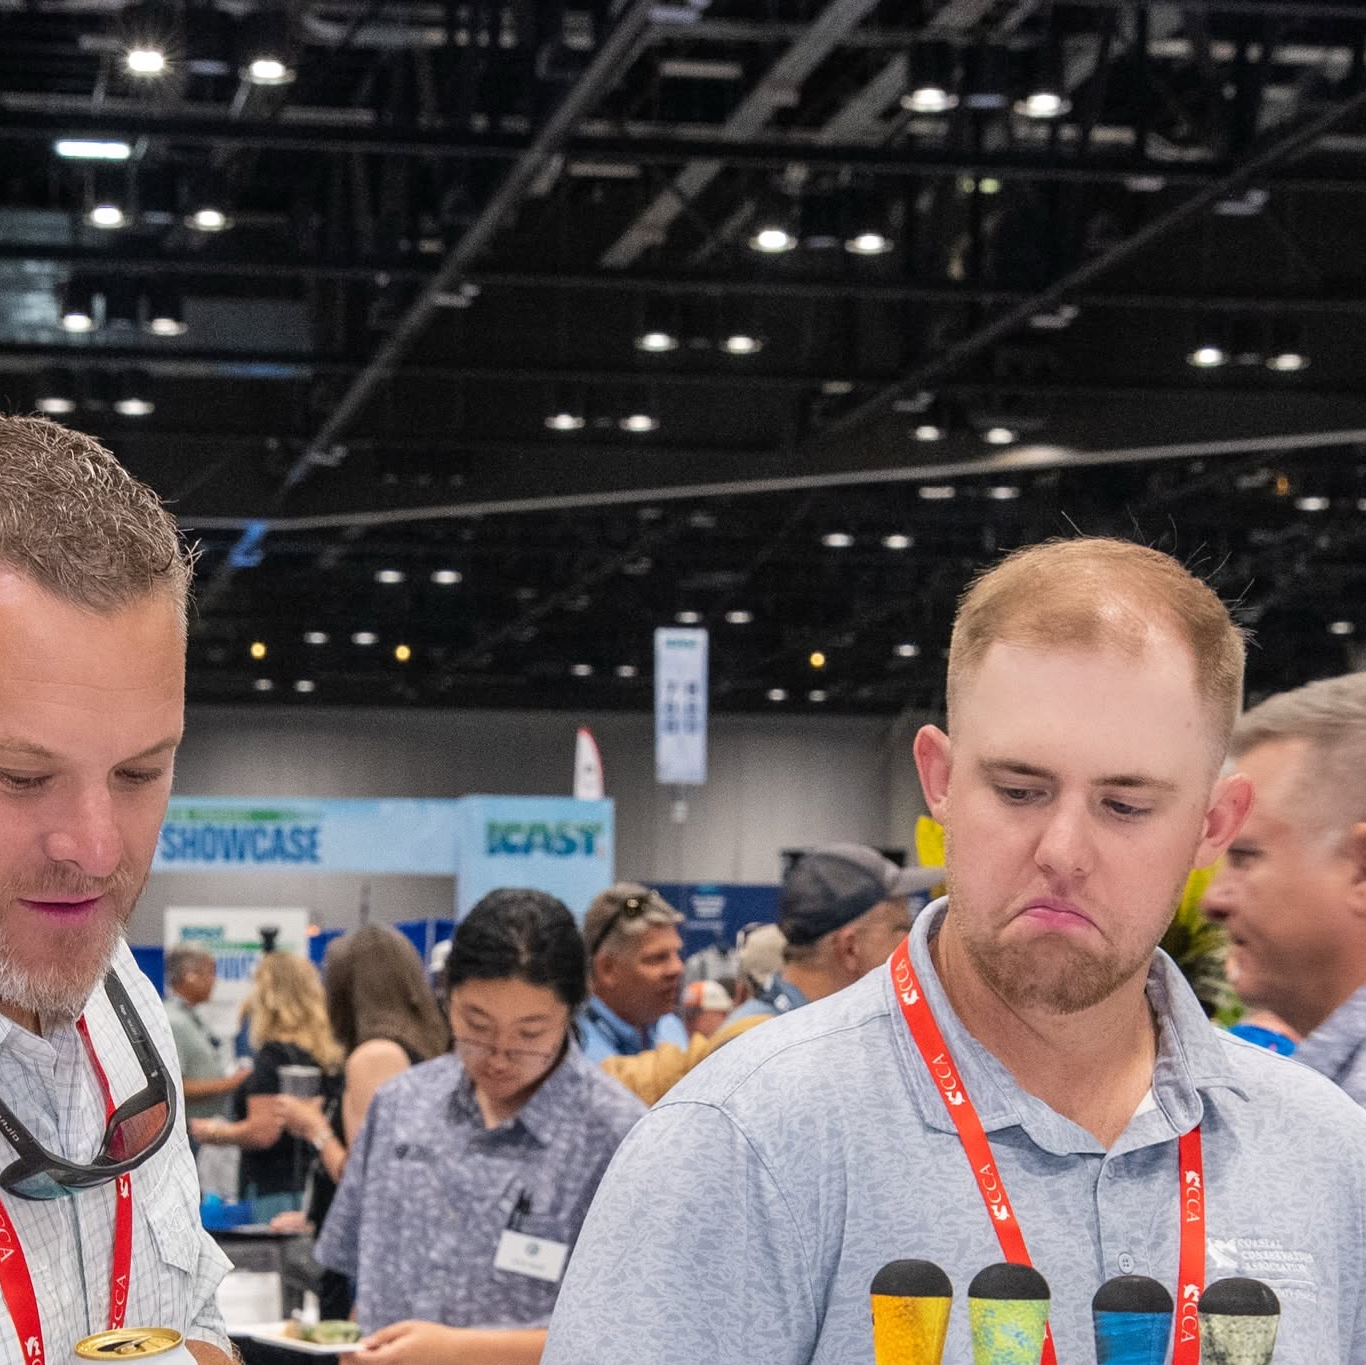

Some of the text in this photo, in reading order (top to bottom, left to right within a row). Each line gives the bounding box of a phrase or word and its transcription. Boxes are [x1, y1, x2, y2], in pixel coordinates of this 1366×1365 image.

[159, 823, 321, 865] SHOWCASE
[895, 958, 913, 994] CCA
[931, 1052, 959, 1090] CCA
[978, 1163, 1003, 1208] CCA
[1186, 1186, 1202, 1223] CCA
[112, 1273, 128, 1325] CCA
[1180, 1302, 1198, 1343] CCA
